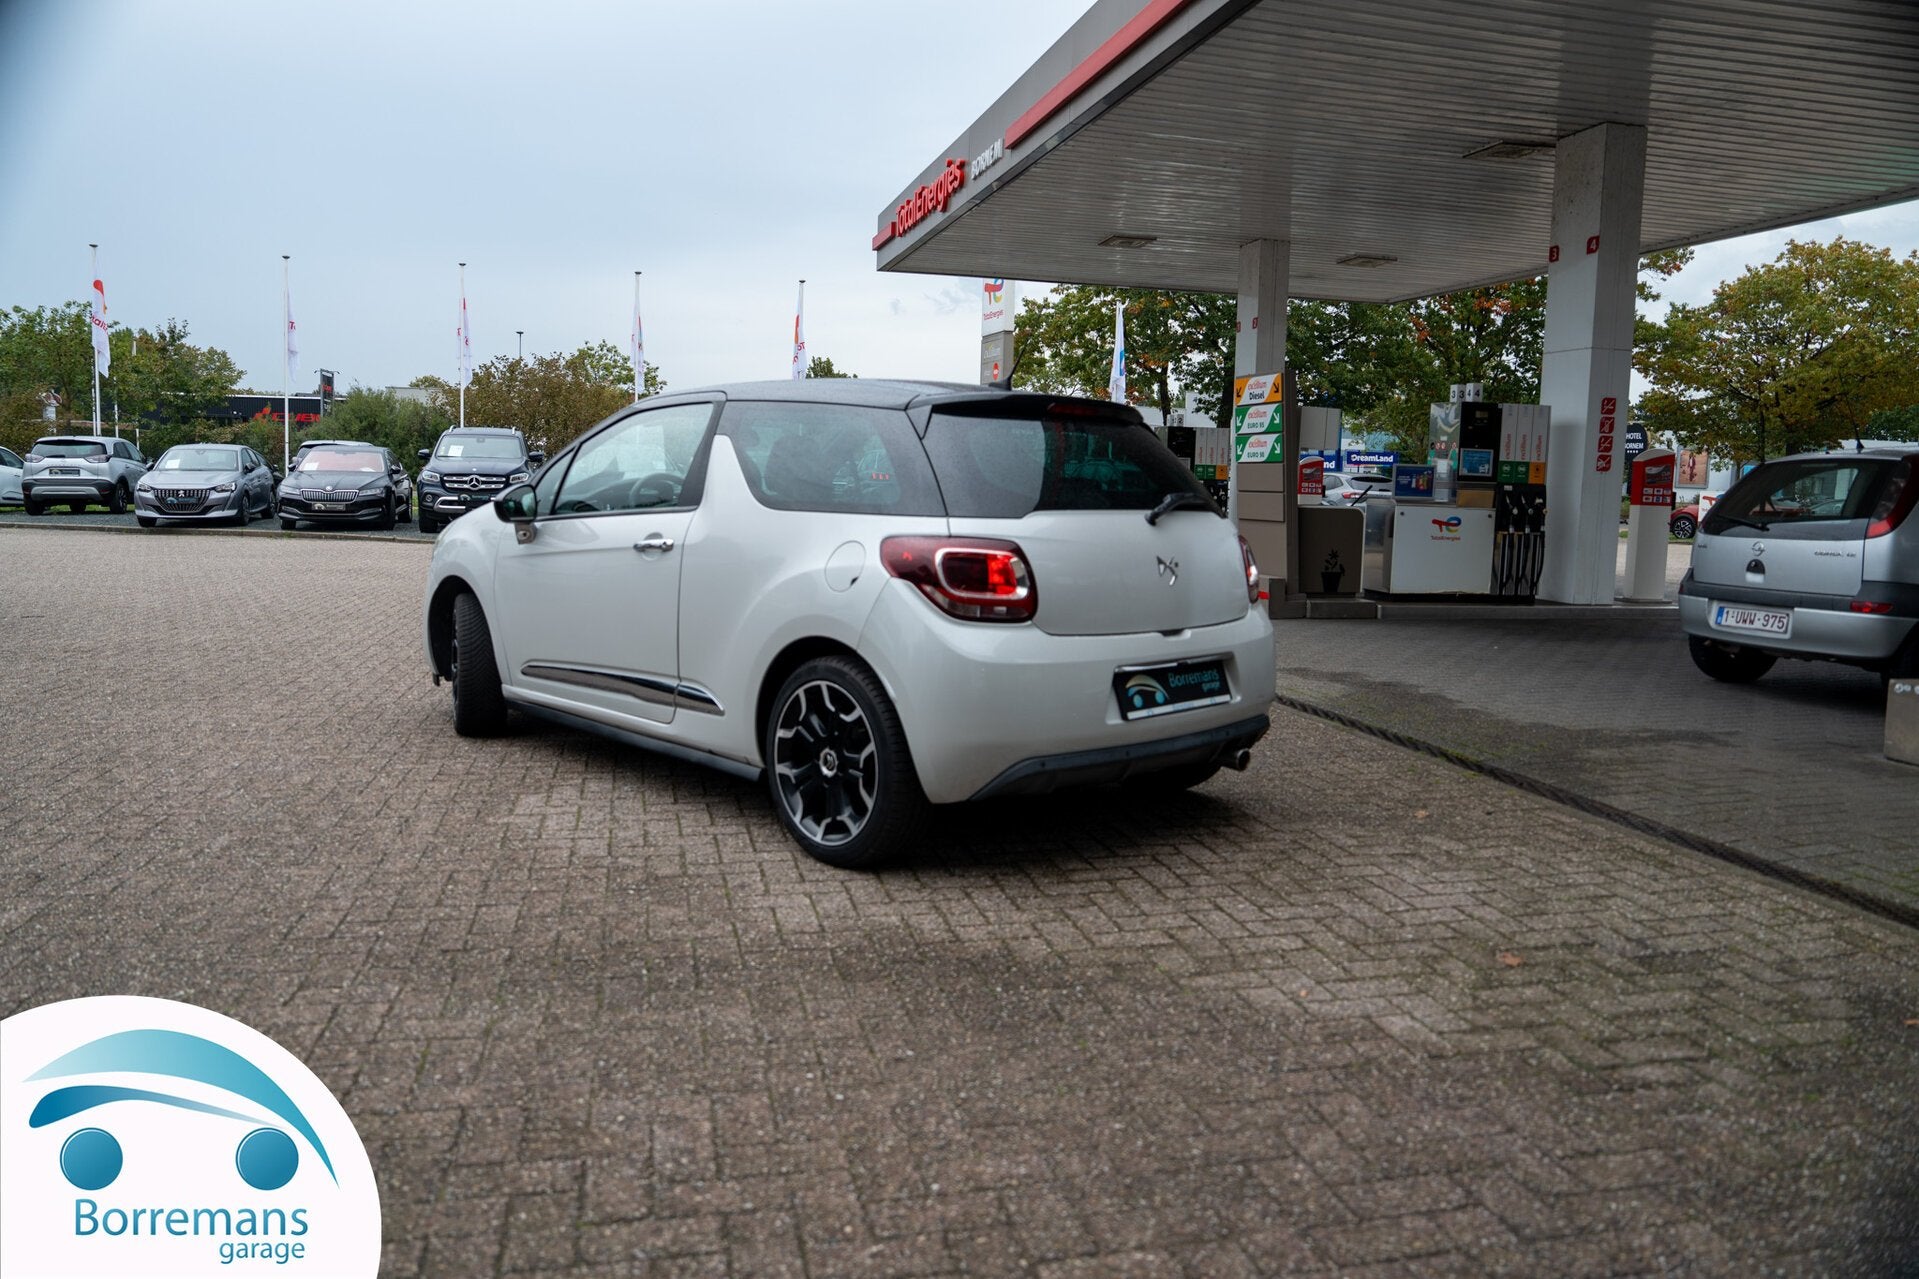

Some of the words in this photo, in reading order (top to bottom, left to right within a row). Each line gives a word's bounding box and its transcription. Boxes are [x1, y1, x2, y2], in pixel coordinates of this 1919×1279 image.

[896, 159, 966, 237] TotalEnergies
[1249, 391, 1265, 400] Diesel
[1351, 454, 1394, 463] DreamLand
[1168, 669, 1220, 688] Borremans
